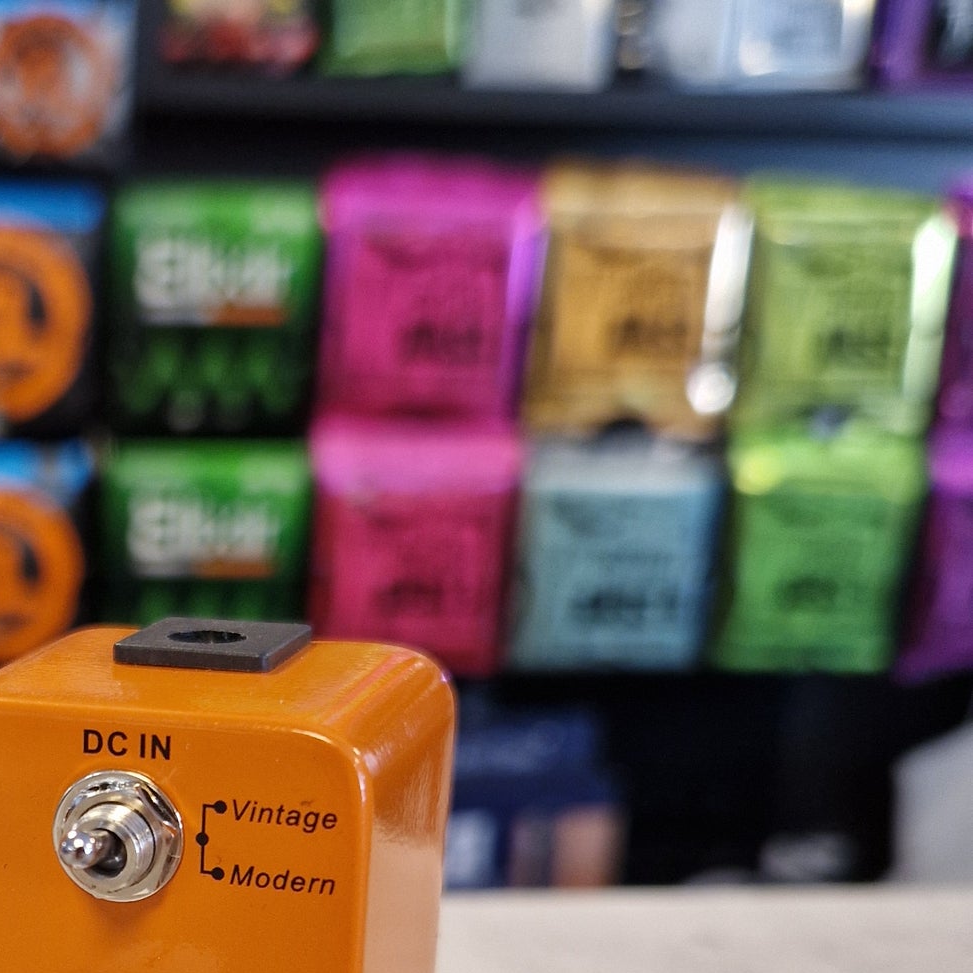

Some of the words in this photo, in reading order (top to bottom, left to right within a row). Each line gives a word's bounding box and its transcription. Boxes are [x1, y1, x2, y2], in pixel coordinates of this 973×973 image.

[83, 729, 128, 755] DC
[140, 734, 171, 760] IN
[231, 799, 338, 834] Vintage
[229, 865, 336, 896] Modern
